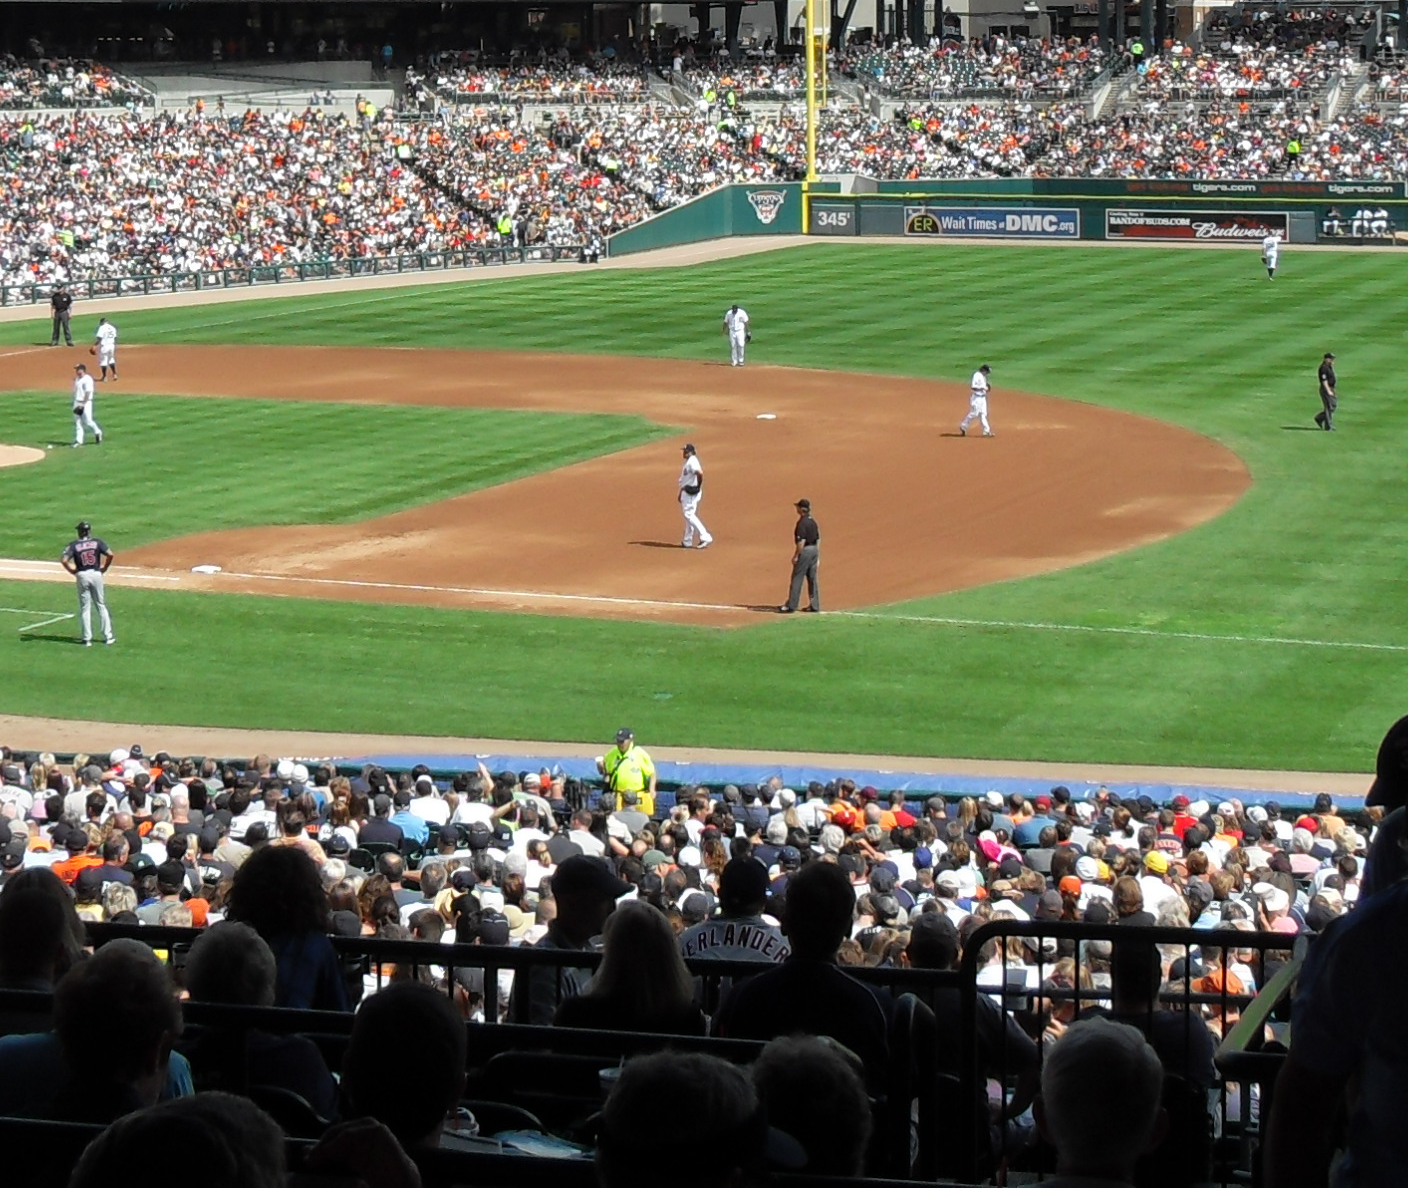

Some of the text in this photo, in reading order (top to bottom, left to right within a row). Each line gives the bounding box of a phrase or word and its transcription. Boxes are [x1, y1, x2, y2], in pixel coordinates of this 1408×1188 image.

[1192, 183, 1256, 193] tigers.com
[1328, 183, 1393, 194] tigers.com
[818, 212, 851, 227] 345'
[913, 215, 1075, 233] ER Wait Times DMC.org
[81, 550, 96, 566] 15
[682, 923, 790, 963] ERLANDER
